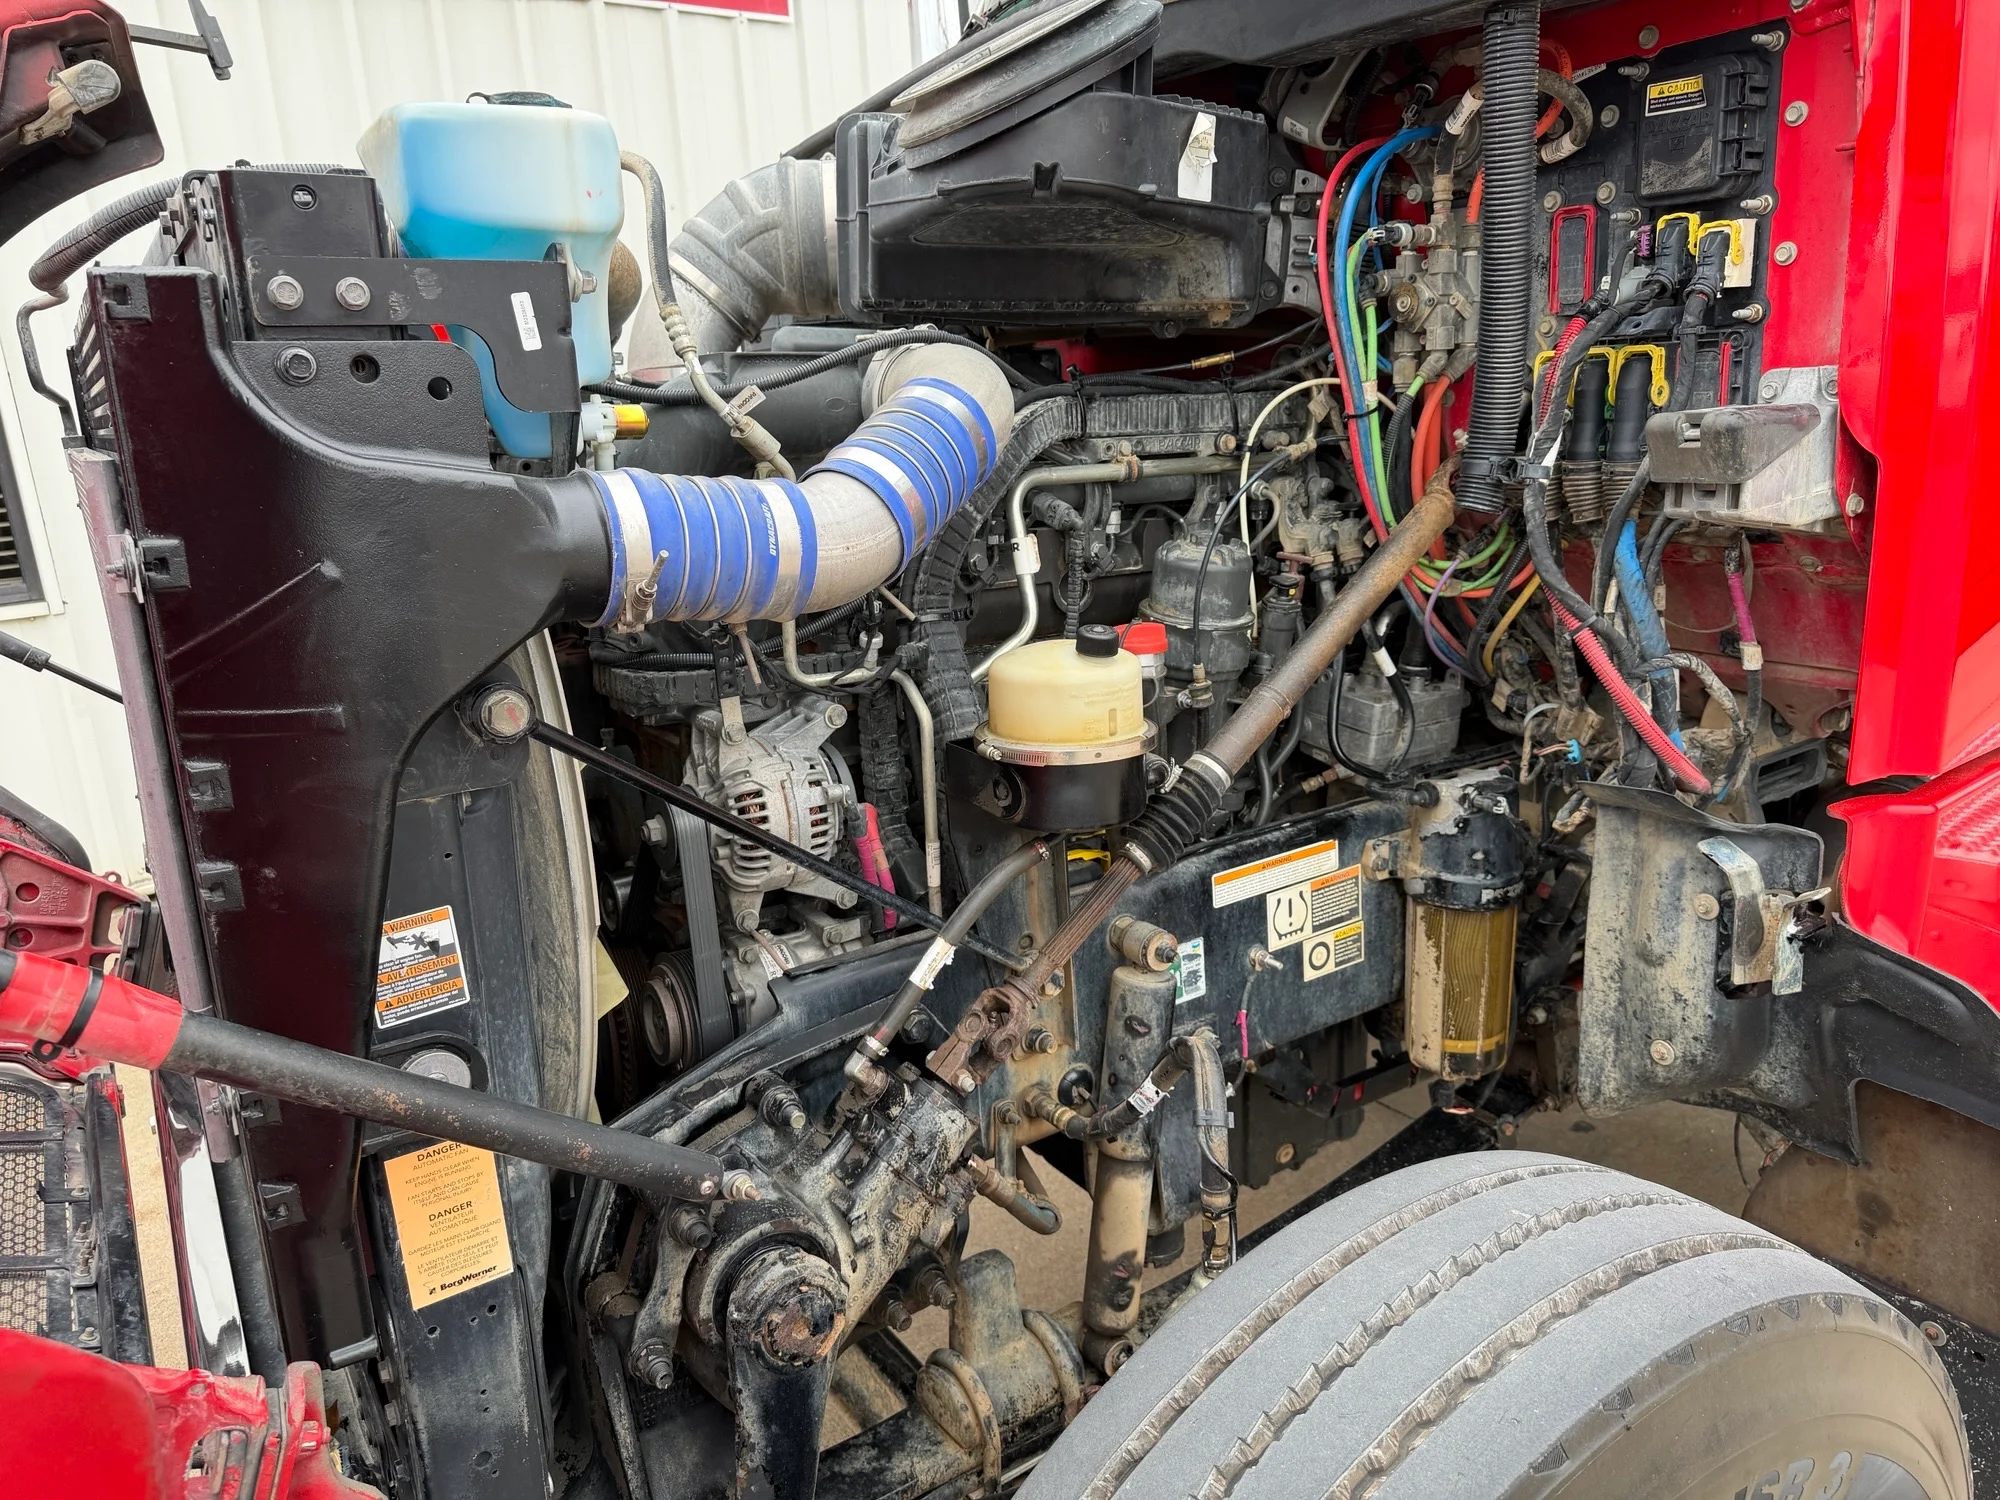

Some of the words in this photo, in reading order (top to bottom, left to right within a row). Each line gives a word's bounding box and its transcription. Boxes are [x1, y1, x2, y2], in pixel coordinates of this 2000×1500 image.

[1667, 80, 1700, 93] CAUTIO
[737, 391, 757, 409] PACCAR
[1157, 436, 1202, 450] PACCAR
[1265, 855, 1292, 868] WARNING
[1325, 871, 1350, 884] WARNING
[389, 913, 434, 932] WARNING
[1339, 925, 1362, 938] CAUTION
[397, 981, 458, 1005] ADVERTENCIA
[413, 1153, 453, 1171] AUTOMATIC
[455, 1148, 468, 1156] FAN
[417, 1143, 462, 1162] DANGER
[406, 1176, 420, 1184] KEEP
[421, 1169, 442, 1179] HANDS
[443, 1162, 461, 1171] CLEAR
[462, 1156, 479, 1165] WHEN
[414, 1195, 430, 1204] ITSELF
[433, 1190, 446, 1198] AND
[461, 1178, 479, 1188] CAUSE
[415, 1176, 437, 1187] ENGINE
[421, 1186, 442, 1196] STARTS
[443, 1181, 456, 1189] AND
[457, 1174, 475, 1184] STOPS
[422, 1195, 451, 1207] PERSONAL
[429, 1201, 472, 1221] DANGER
[430, 1209, 473, 1228] VENTILATEUR
[429, 1215, 477, 1236] AUTOMATIQUE
[408, 1244, 431, 1255] GARDEZ
[444, 1233, 462, 1242] MAINS
[463, 1227, 479, 1235] CLAIR
[480, 1218, 500, 1229] QUAND
[420, 1245, 445, 1257] MOTEUR
[425, 1249, 462, 1266] VENTILATEUR
[446, 1255, 461, 1264] TOUT
[463, 1250, 476, 1258] SEUL
[485, 1241, 498, 1249] PEUT
[427, 1265, 450, 1276] CAUSER
[451, 1260, 462, 1268] DES
[463, 1249, 492, 1263] BLESSURES
[440, 1266, 496, 1291] BorgWarner
[1734, 1457, 1815, 1500] SR
